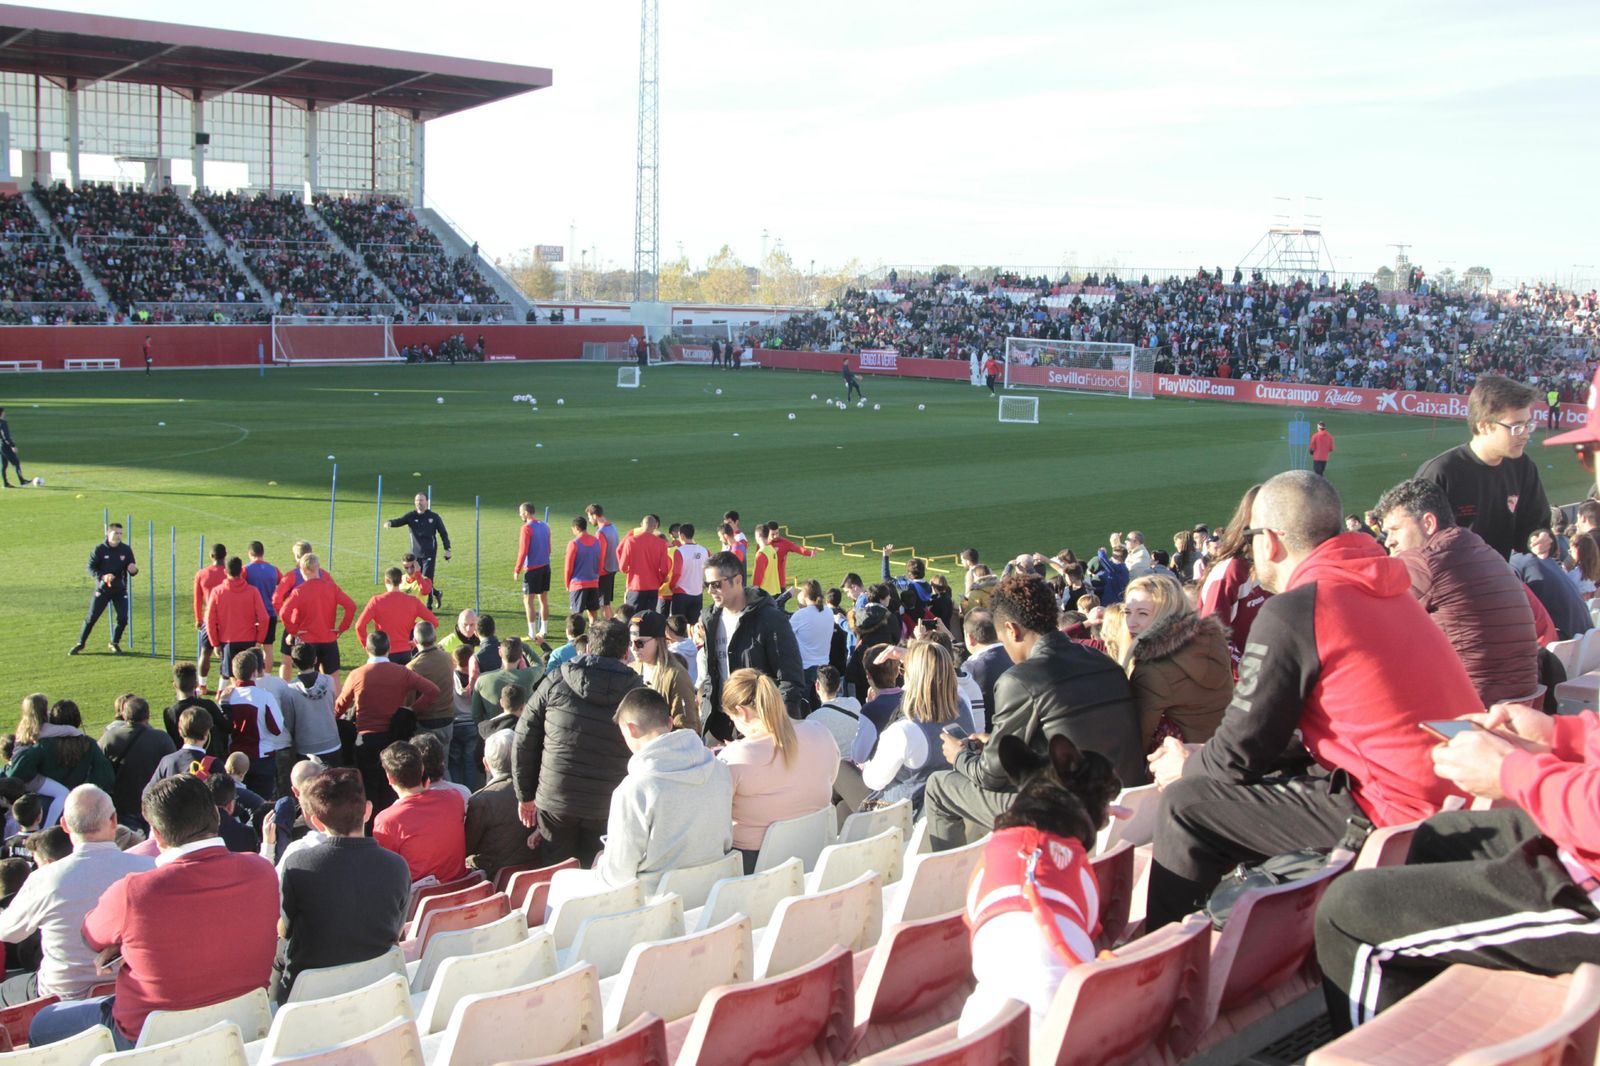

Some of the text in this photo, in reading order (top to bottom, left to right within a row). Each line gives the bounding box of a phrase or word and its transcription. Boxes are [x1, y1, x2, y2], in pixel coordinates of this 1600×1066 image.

[1048, 370, 1143, 389] SevillaFútbolClb
[1158, 377, 1235, 396] PlayWSOP.com
[1255, 384, 1363, 406] Cruzcampo Radler
[1401, 393, 1469, 417] CaixaBa
